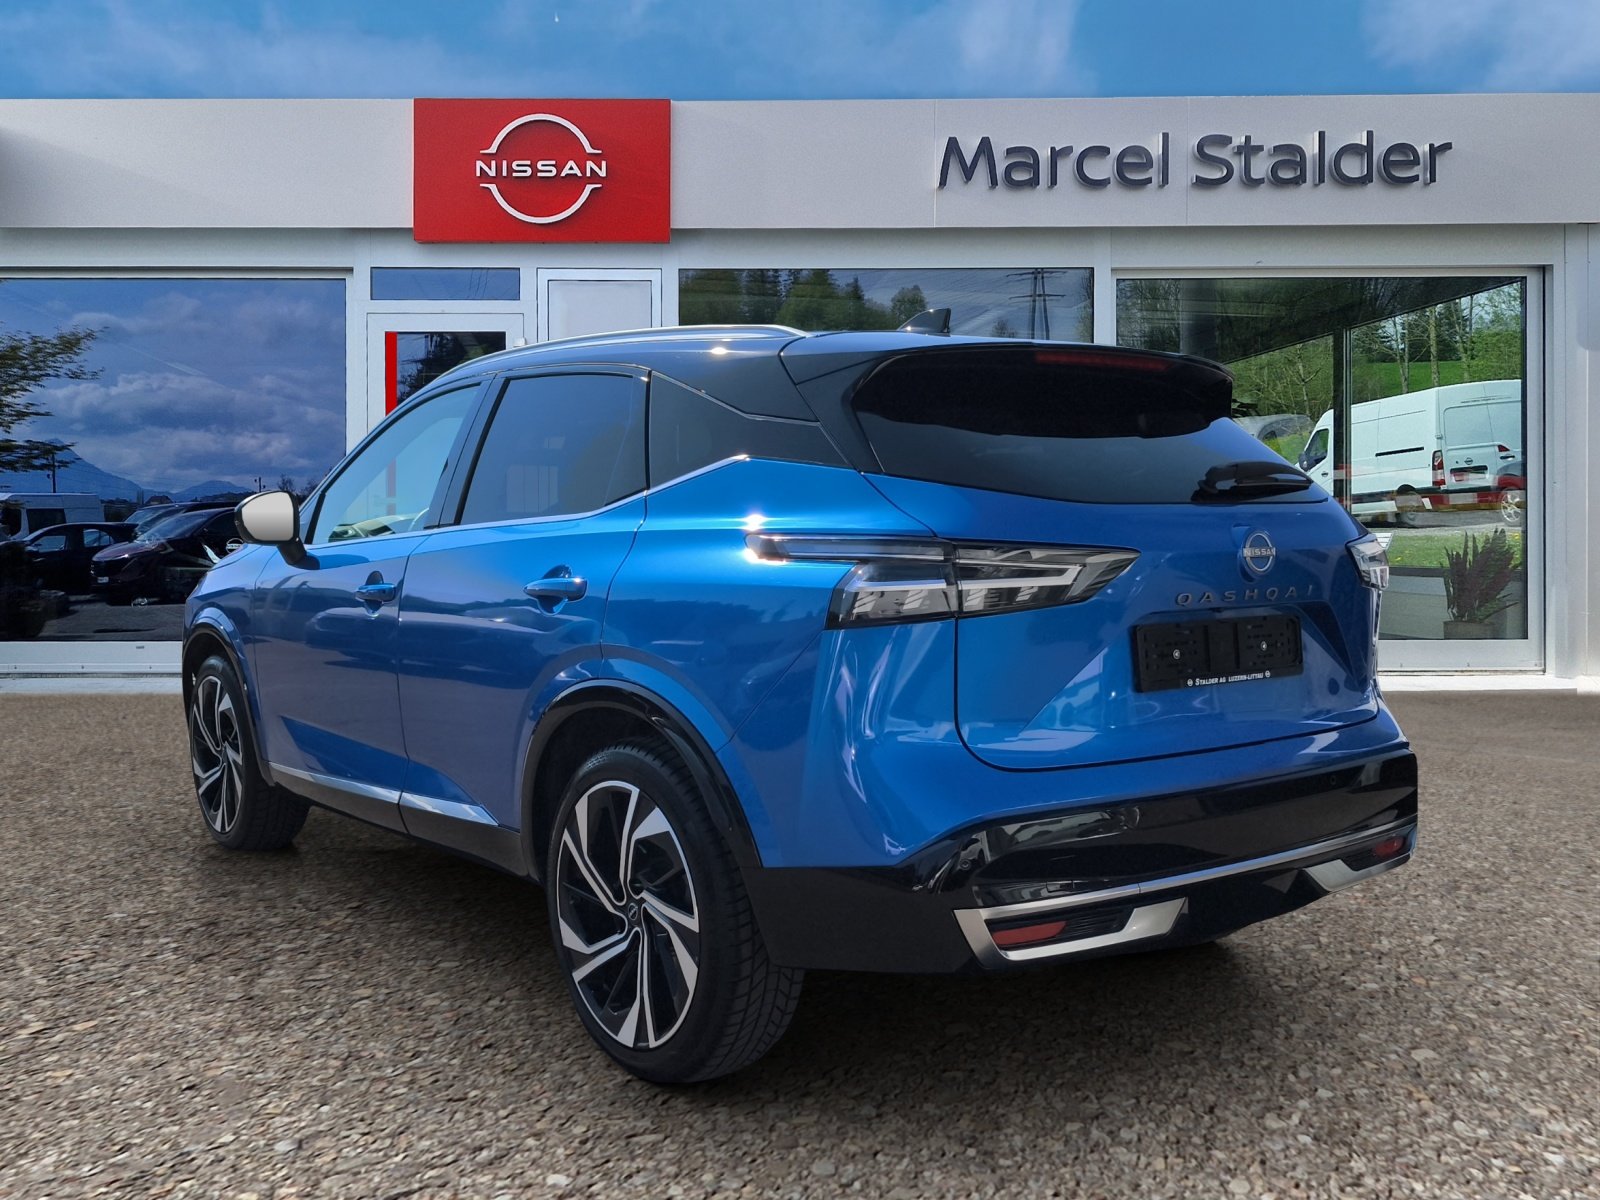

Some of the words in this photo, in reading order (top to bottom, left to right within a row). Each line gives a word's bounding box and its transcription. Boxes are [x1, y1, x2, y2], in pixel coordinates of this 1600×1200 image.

[475, 160, 607, 177] NISSAN
[938, 132, 1169, 189] Marcel
[1192, 130, 1453, 186] Stalder
[1244, 547, 1276, 557] NISSAN
[1175, 585, 1313, 606] QASHQAI
